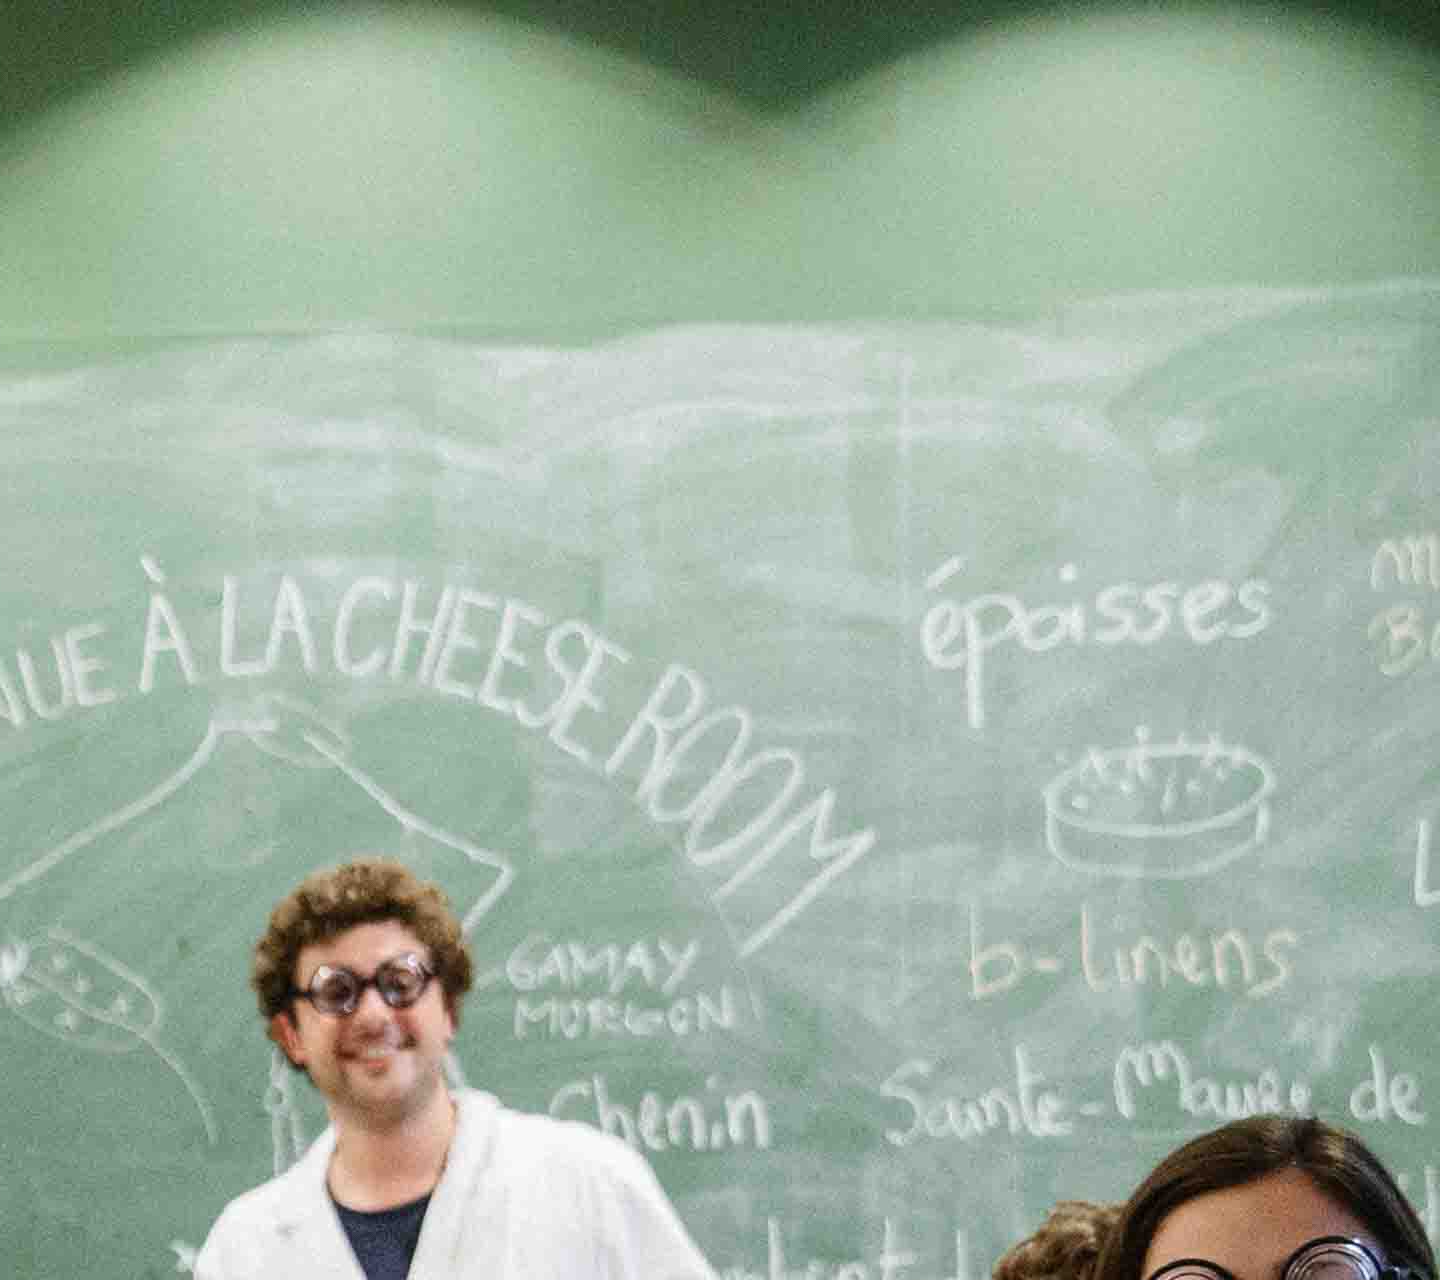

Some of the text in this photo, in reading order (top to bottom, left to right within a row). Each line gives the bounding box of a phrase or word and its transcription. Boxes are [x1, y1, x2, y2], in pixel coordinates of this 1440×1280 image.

[138, 554, 200, 694] À
[220, 574, 319, 678] LA
[332, 574, 633, 764] CHEESE
[604, 662, 878, 960] ROOM
[1348, 1043, 1426, 1126] de
